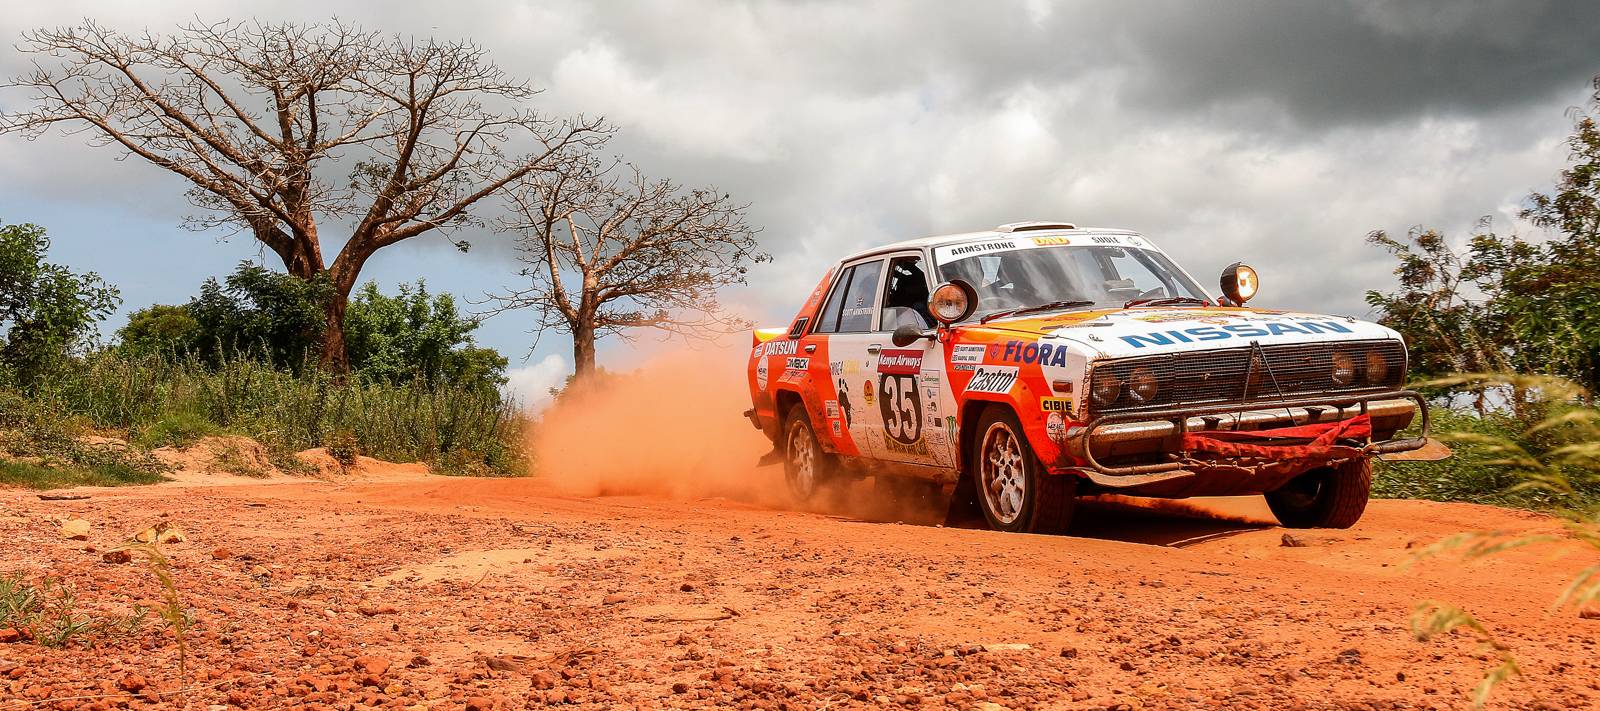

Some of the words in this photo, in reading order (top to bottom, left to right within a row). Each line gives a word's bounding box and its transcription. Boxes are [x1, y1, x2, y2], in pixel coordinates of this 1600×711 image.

[951, 242, 1016, 256] ARMSTRONG
[1119, 321, 1353, 349] NISSAN
[765, 341, 798, 355] DATSUN
[1003, 340, 1068, 367] FLORA
[880, 355, 897, 368] Kenya
[896, 355, 921, 368] Airways
[967, 367, 1018, 392] Castrol
[884, 375, 917, 440] 35
[1043, 400, 1072, 411] CIBIE
